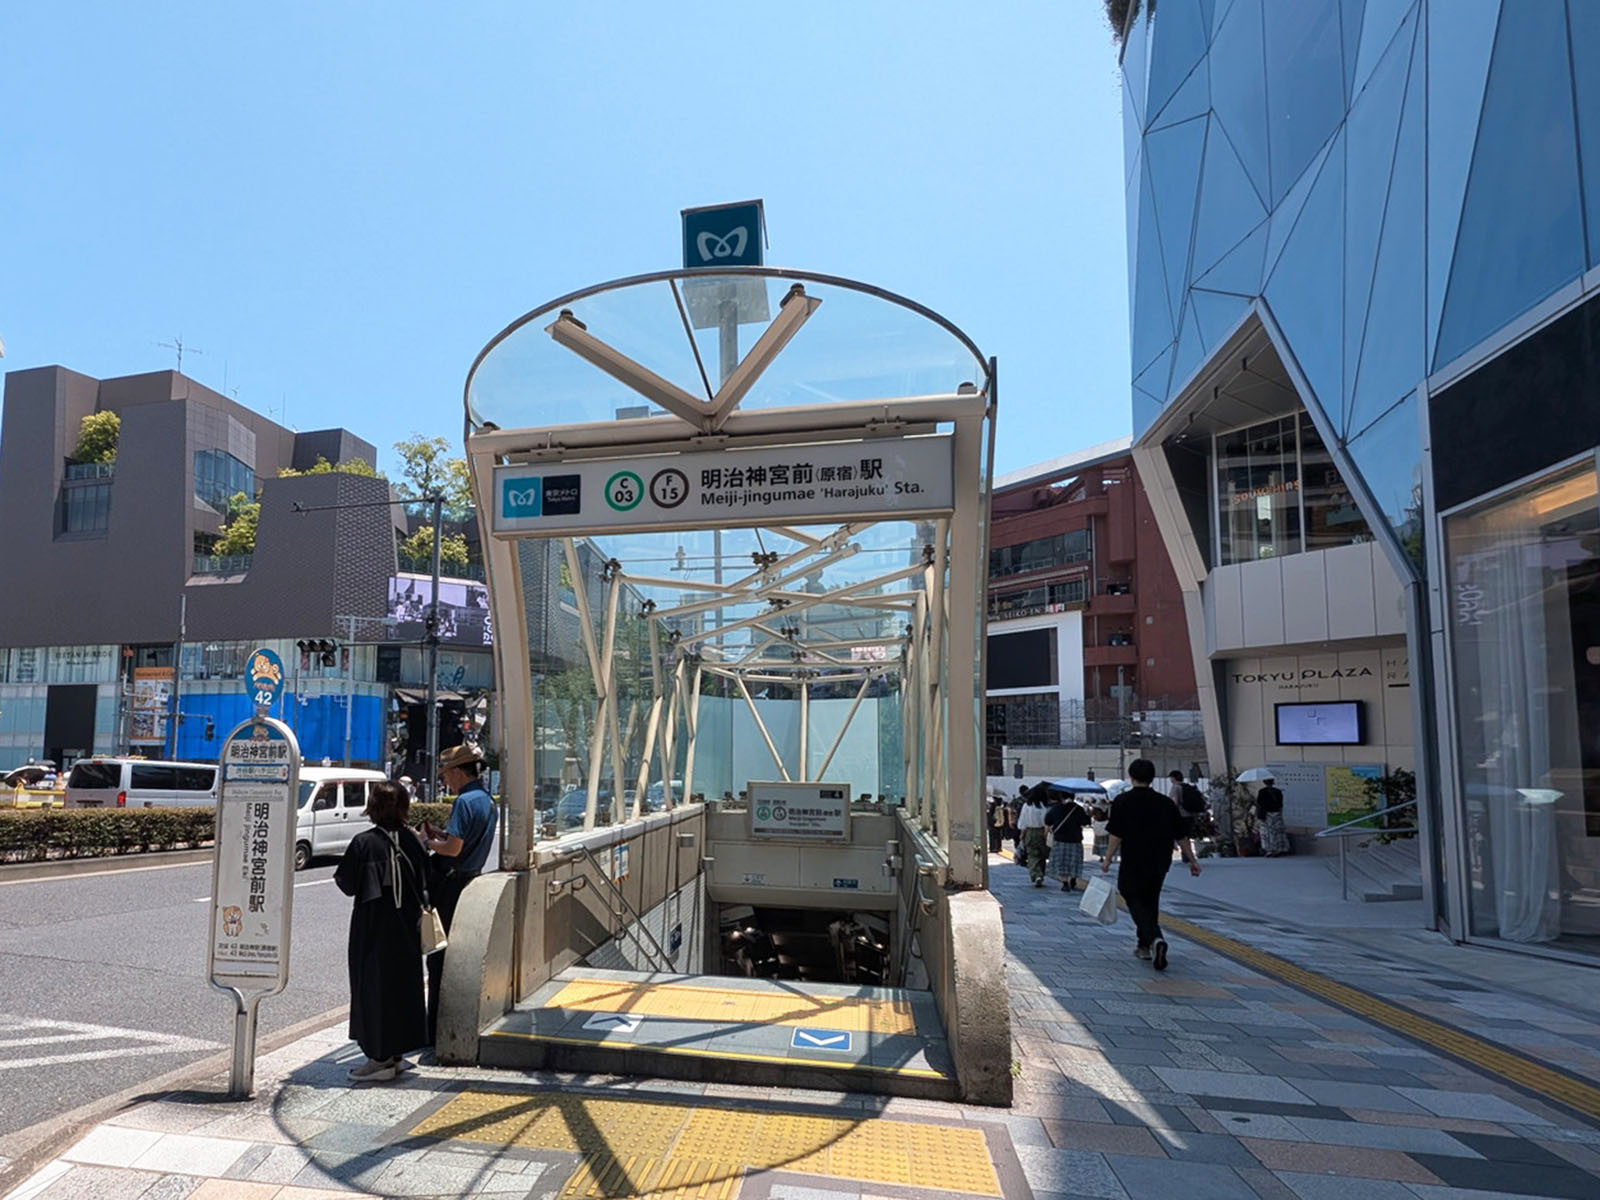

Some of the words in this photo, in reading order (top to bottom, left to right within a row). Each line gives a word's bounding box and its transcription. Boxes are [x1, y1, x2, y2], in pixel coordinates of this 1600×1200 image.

[620, 477, 629, 489] C
[666, 475, 673, 486] F
[614, 490, 634, 503] 03
[662, 487, 679, 500] 15
[701, 488, 815, 507] Meiji-jingumae
[894, 480, 924, 494] Sta.
[1232, 671, 1294, 684] TOKYU
[1301, 667, 1373, 680] PLAZA
[254, 690, 273, 705] 42
[230, 743, 288, 759] 明治神宮前駅
[248, 802, 270, 913] 明治神宮前駅
